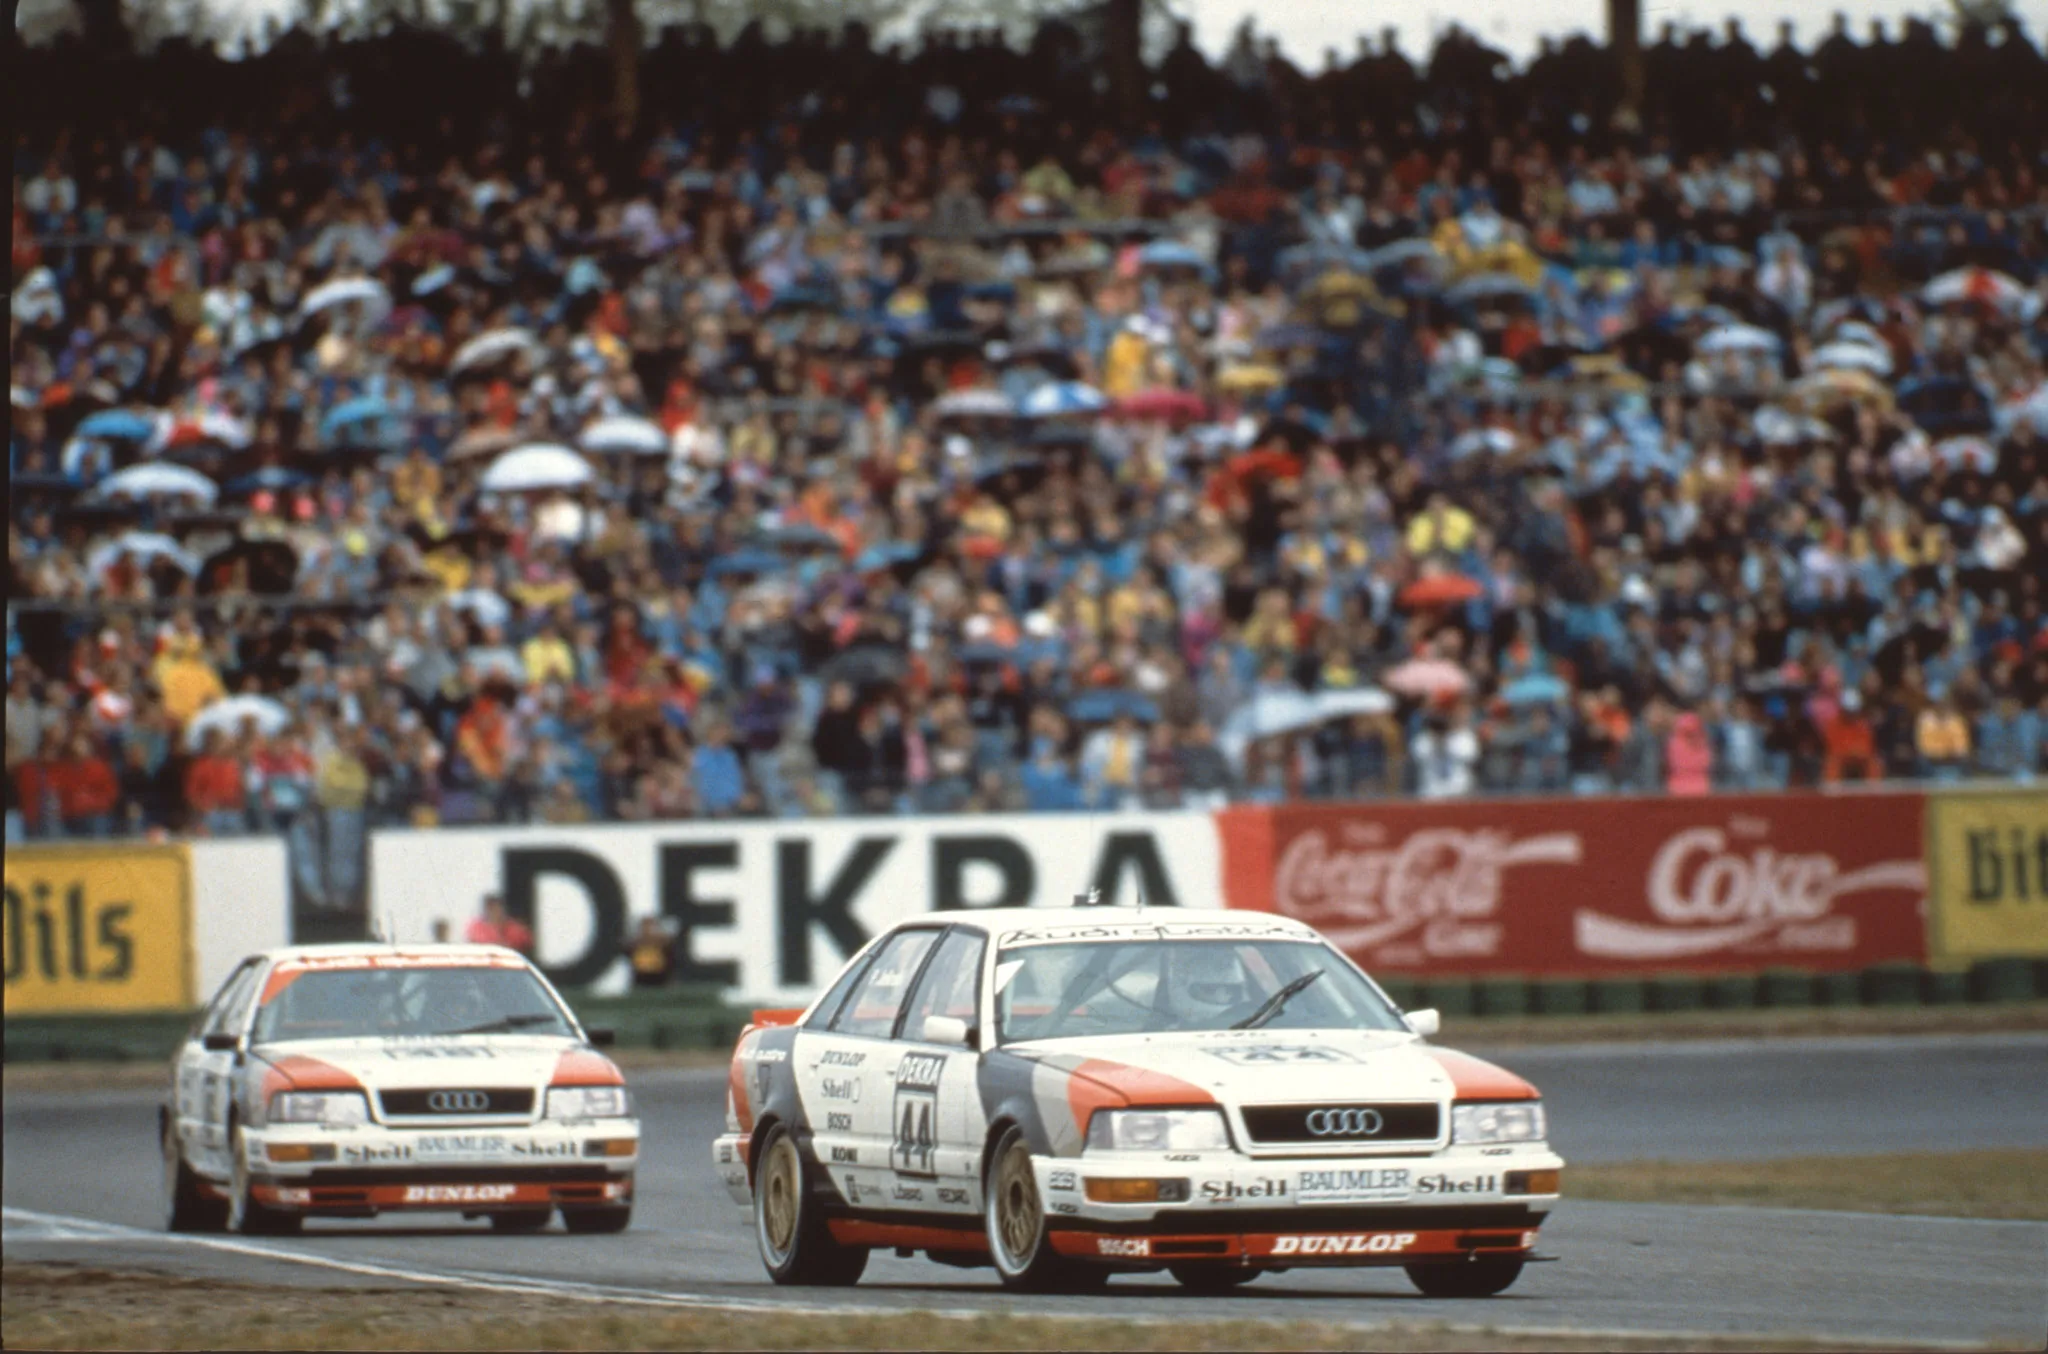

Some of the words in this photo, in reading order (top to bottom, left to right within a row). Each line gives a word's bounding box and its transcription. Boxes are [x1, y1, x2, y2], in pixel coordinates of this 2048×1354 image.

[1647, 826, 1840, 923] Coke
[1004, 926, 1119, 944] Audi
[820, 1050, 867, 1067] DUNLOP
[821, 1078, 852, 1099] Shell
[896, 1100, 933, 1169] 44
[344, 1143, 412, 1161] Shell
[511, 1140, 578, 1157] Shell
[404, 1183, 517, 1202] DUNLOP
[1201, 1177, 1288, 1198] Shell
[1417, 1174, 1496, 1195] Shell
[1270, 1233, 1418, 1255] DUNLOP
